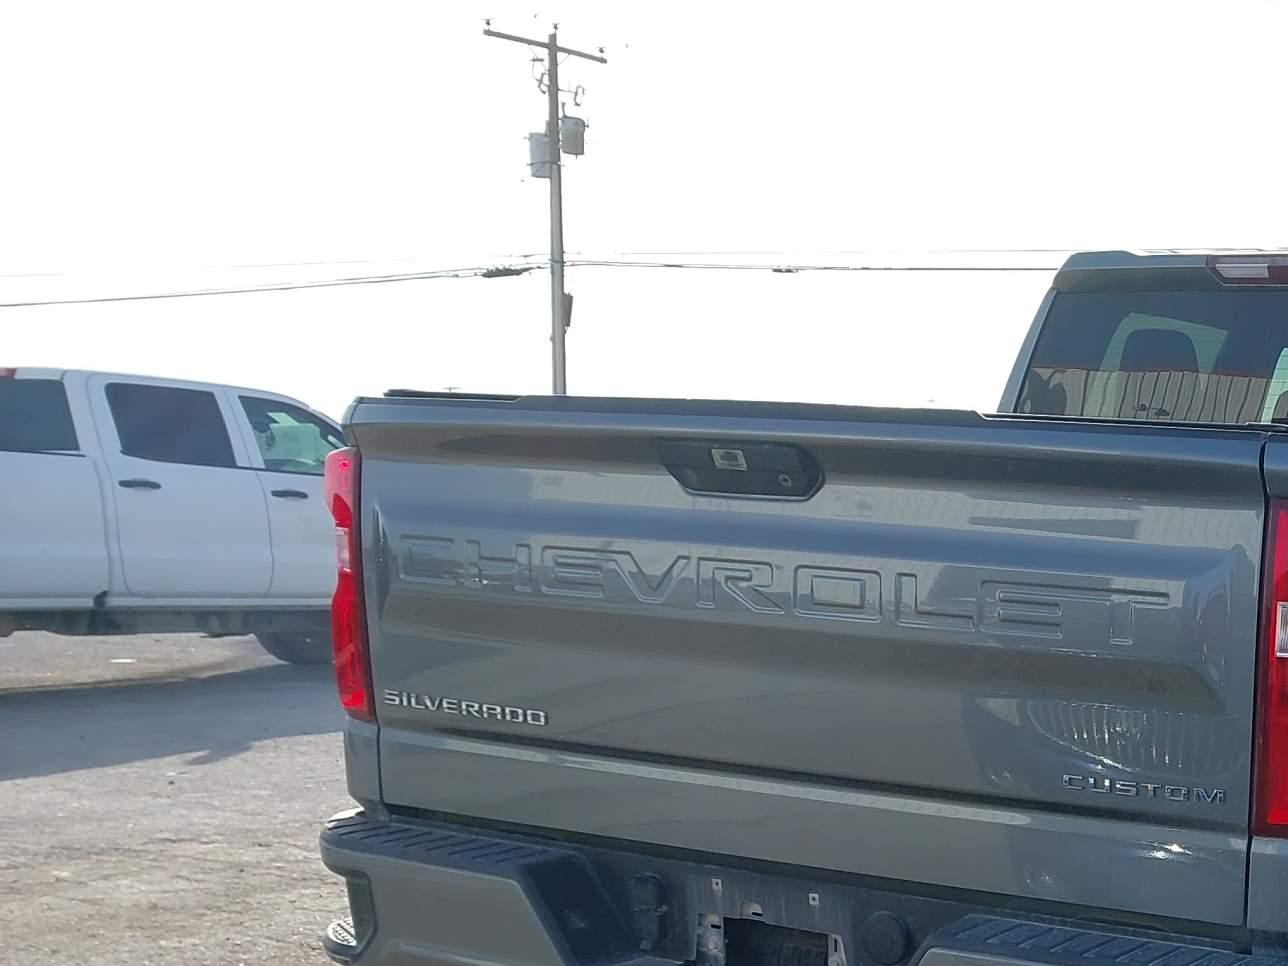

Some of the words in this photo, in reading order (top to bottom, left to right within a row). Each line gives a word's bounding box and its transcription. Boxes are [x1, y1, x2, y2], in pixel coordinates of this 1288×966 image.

[399, 533, 1172, 646] CHEVROLET
[383, 688, 549, 727] SILVERADO
[1062, 773, 1227, 805] CUSTOM
